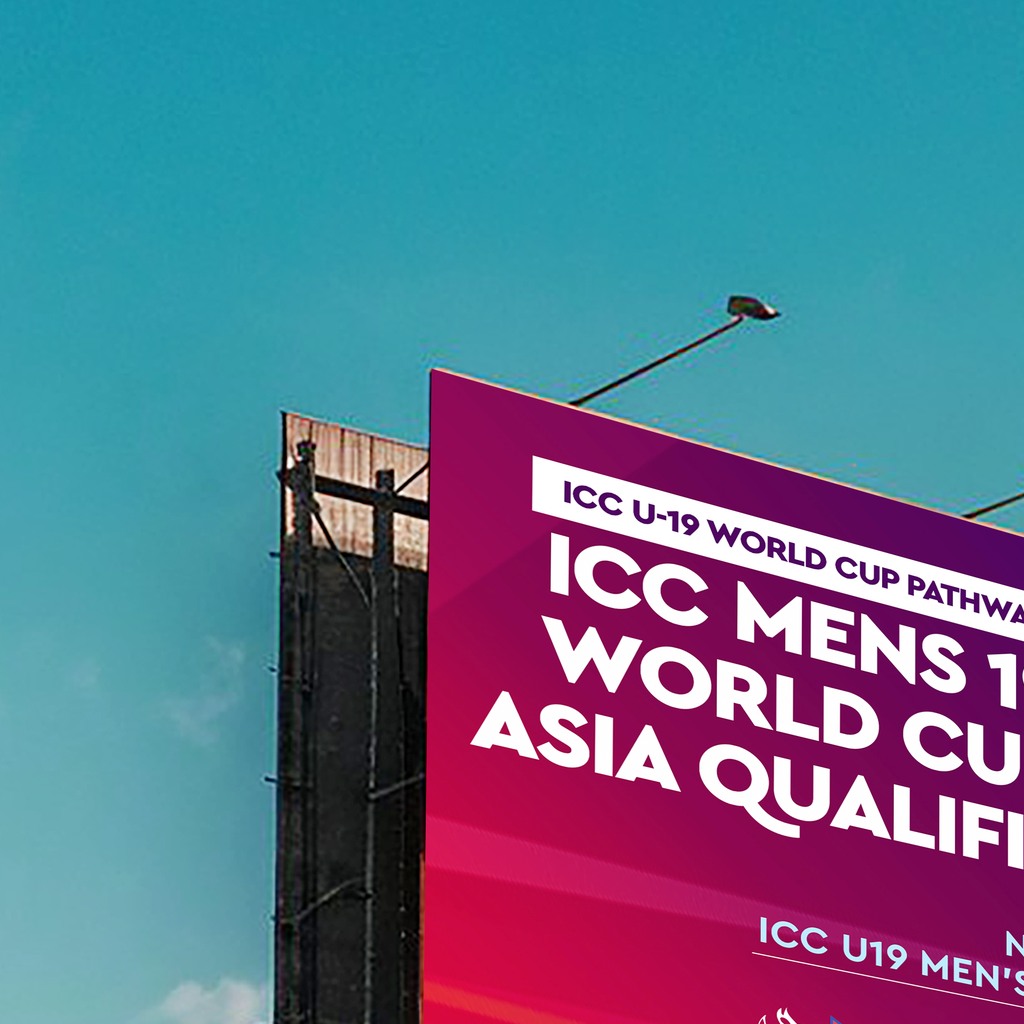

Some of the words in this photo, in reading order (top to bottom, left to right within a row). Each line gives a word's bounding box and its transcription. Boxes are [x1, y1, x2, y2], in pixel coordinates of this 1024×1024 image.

[563, 481, 623, 517] ICC
[632, 499, 700, 537] U-19
[707, 519, 826, 571] WORLD
[835, 556, 900, 591] CUP
[550, 532, 708, 626] ICC
[737, 581, 967, 694] MENS
[541, 615, 879, 750] WORLD
[470, 690, 681, 792] ASIA
[759, 917, 828, 955] ICC
[842, 934, 907, 970] U19
